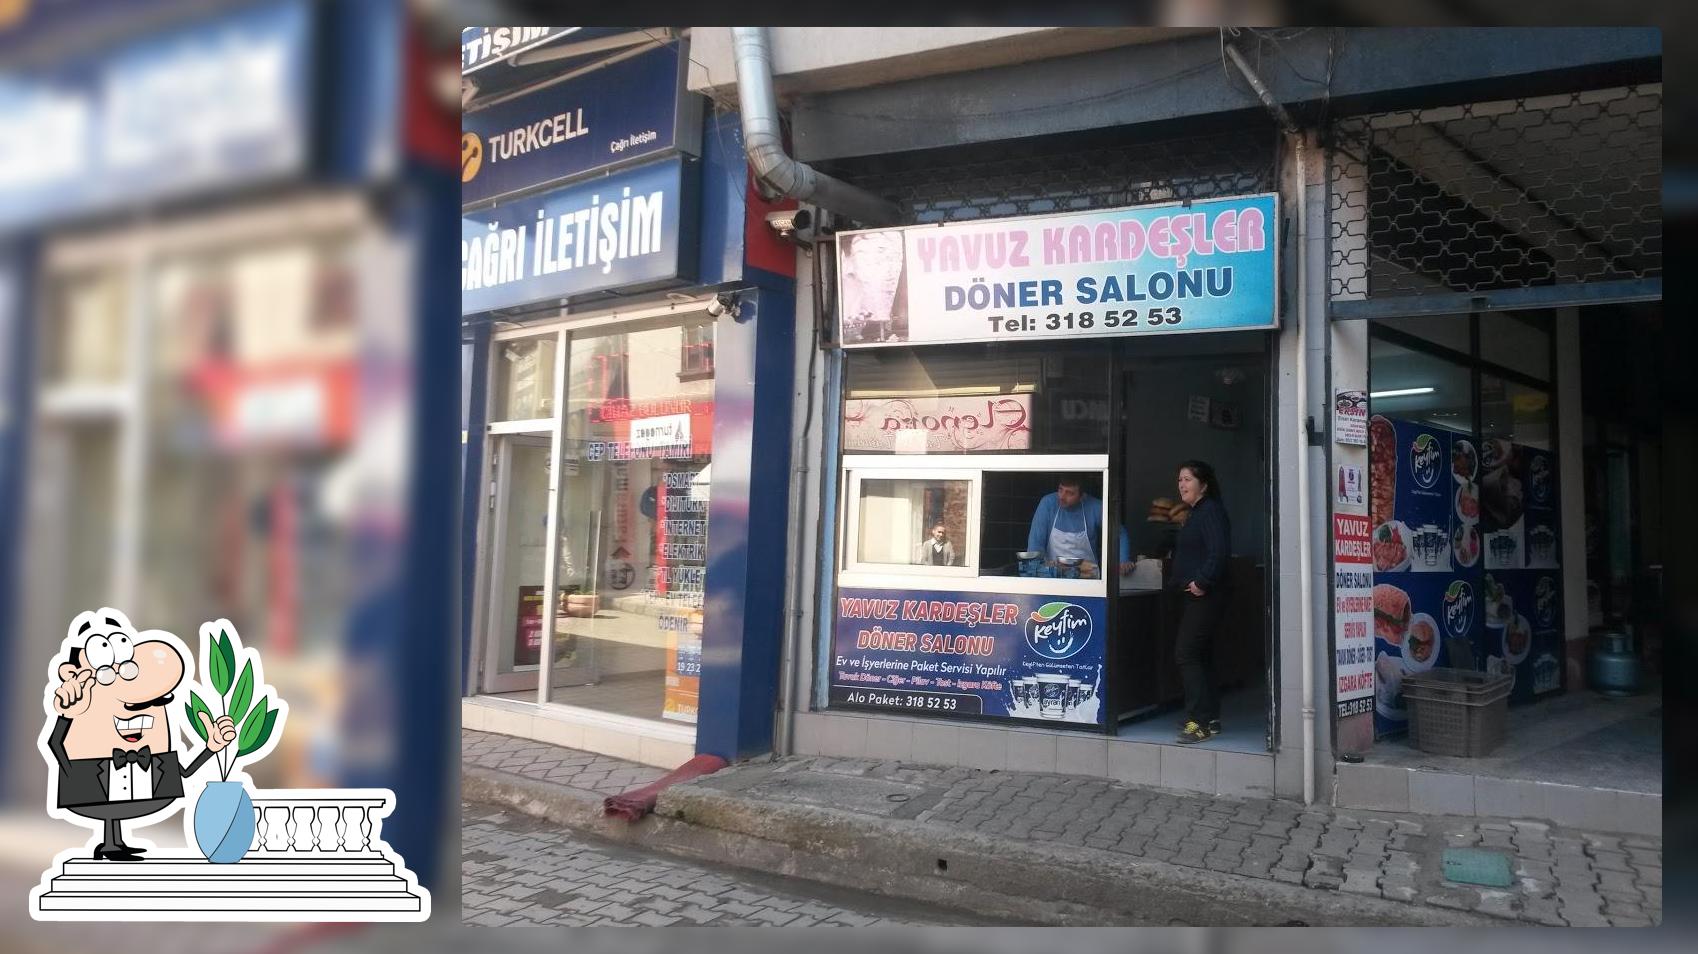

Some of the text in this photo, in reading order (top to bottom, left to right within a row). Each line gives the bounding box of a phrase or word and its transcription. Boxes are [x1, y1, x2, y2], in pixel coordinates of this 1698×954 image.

[488, 108, 589, 163] TURKCELL
[533, 187, 663, 274] İLETİŞİM
[917, 207, 1266, 273] YAVUZ KARDEŞLER
[944, 267, 1233, 311] DÖNER SALONU
[987, 306, 1182, 333] Tel: 318 52 53
[1337, 519, 1369, 537] YAVUZ
[840, 597, 1019, 628] YAVUZ KARDEŞLER
[857, 626, 995, 656] DÖNER SALONU
[835, 655, 1007, 678] Ev ve İşyerlerine Paket Servisi Yapılır
[847, 692, 957, 710] Alo Paket: 318 52 53
